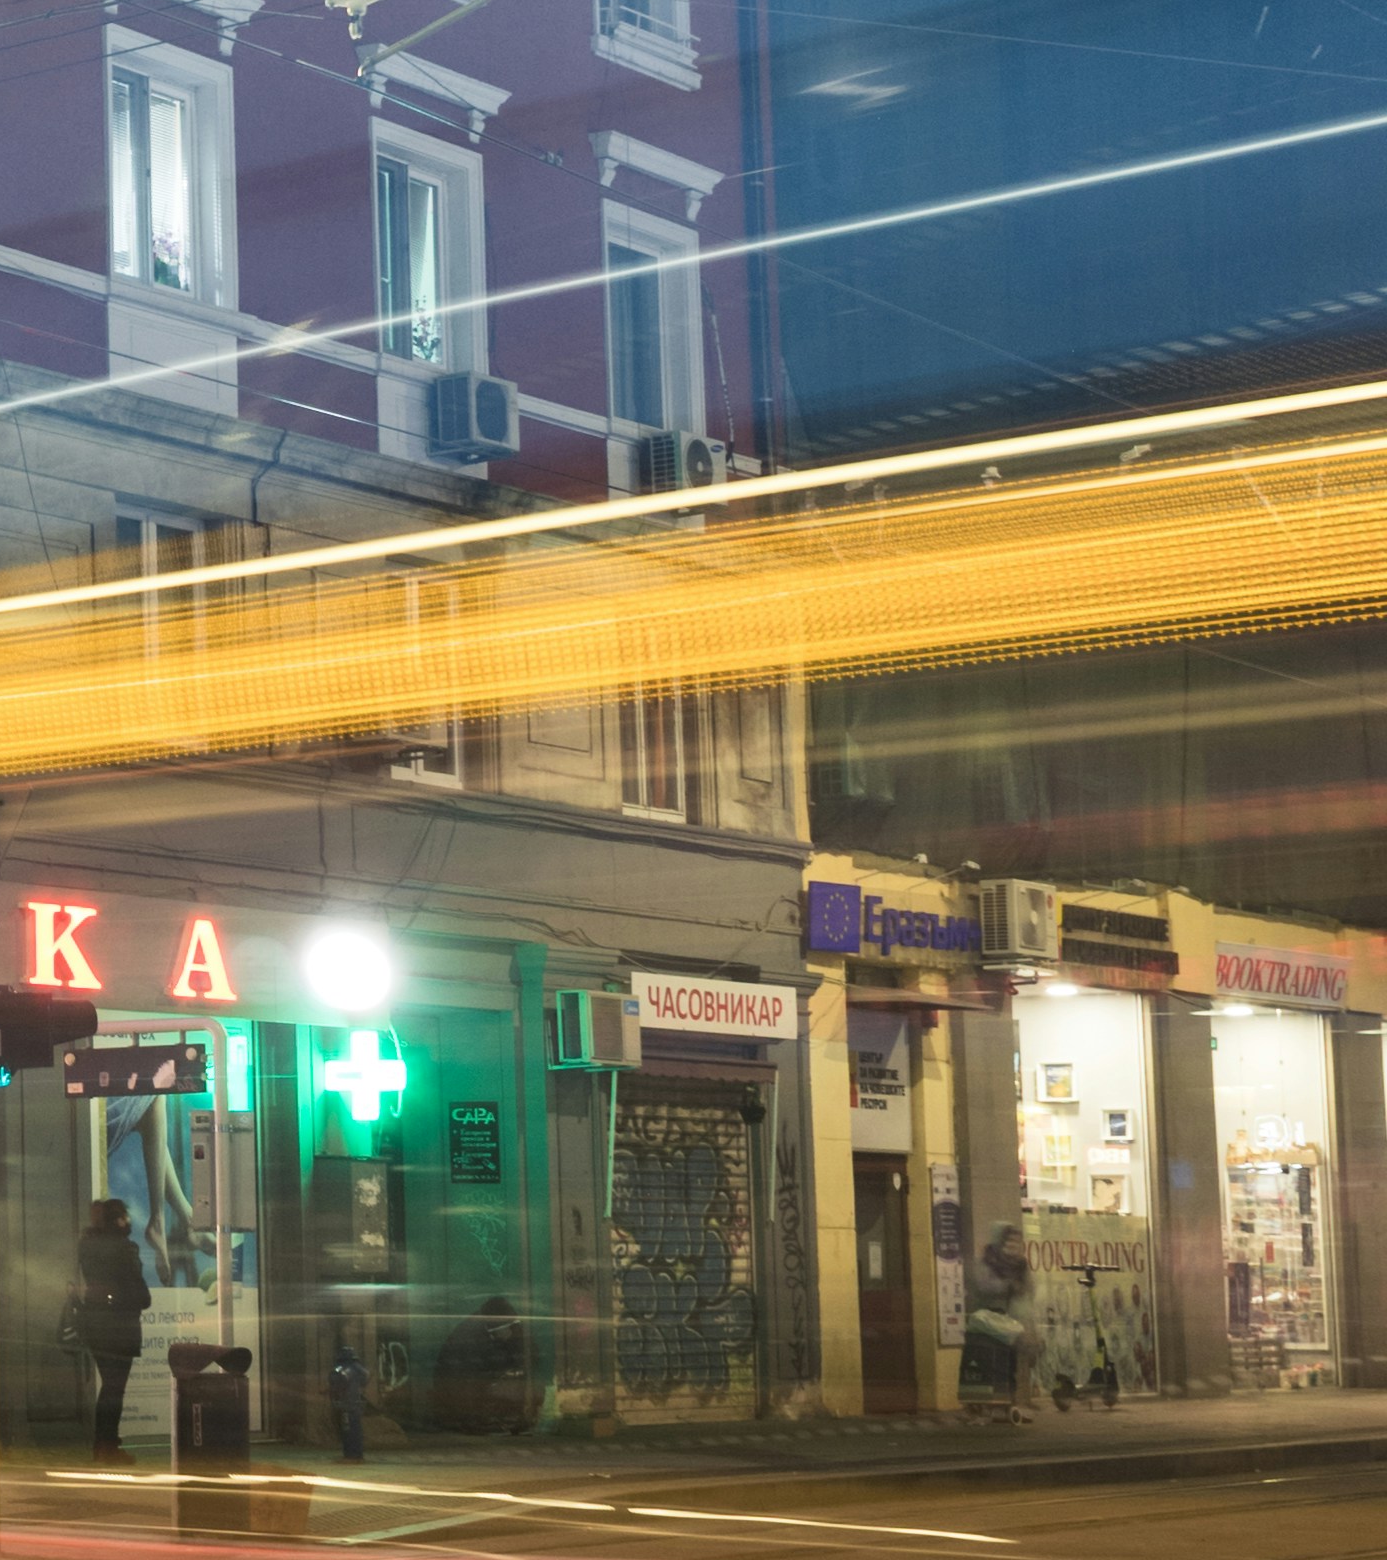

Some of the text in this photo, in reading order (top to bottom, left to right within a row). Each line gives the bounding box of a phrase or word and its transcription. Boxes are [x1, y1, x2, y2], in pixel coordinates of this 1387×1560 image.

[1216, 954, 1346, 1001] BOOKTRADING
[648, 985, 782, 1027] ЧАСОВНИКАР
[1024, 1240, 1144, 1273] OOKTRADING
[158, 1311, 195, 1324] лекота
